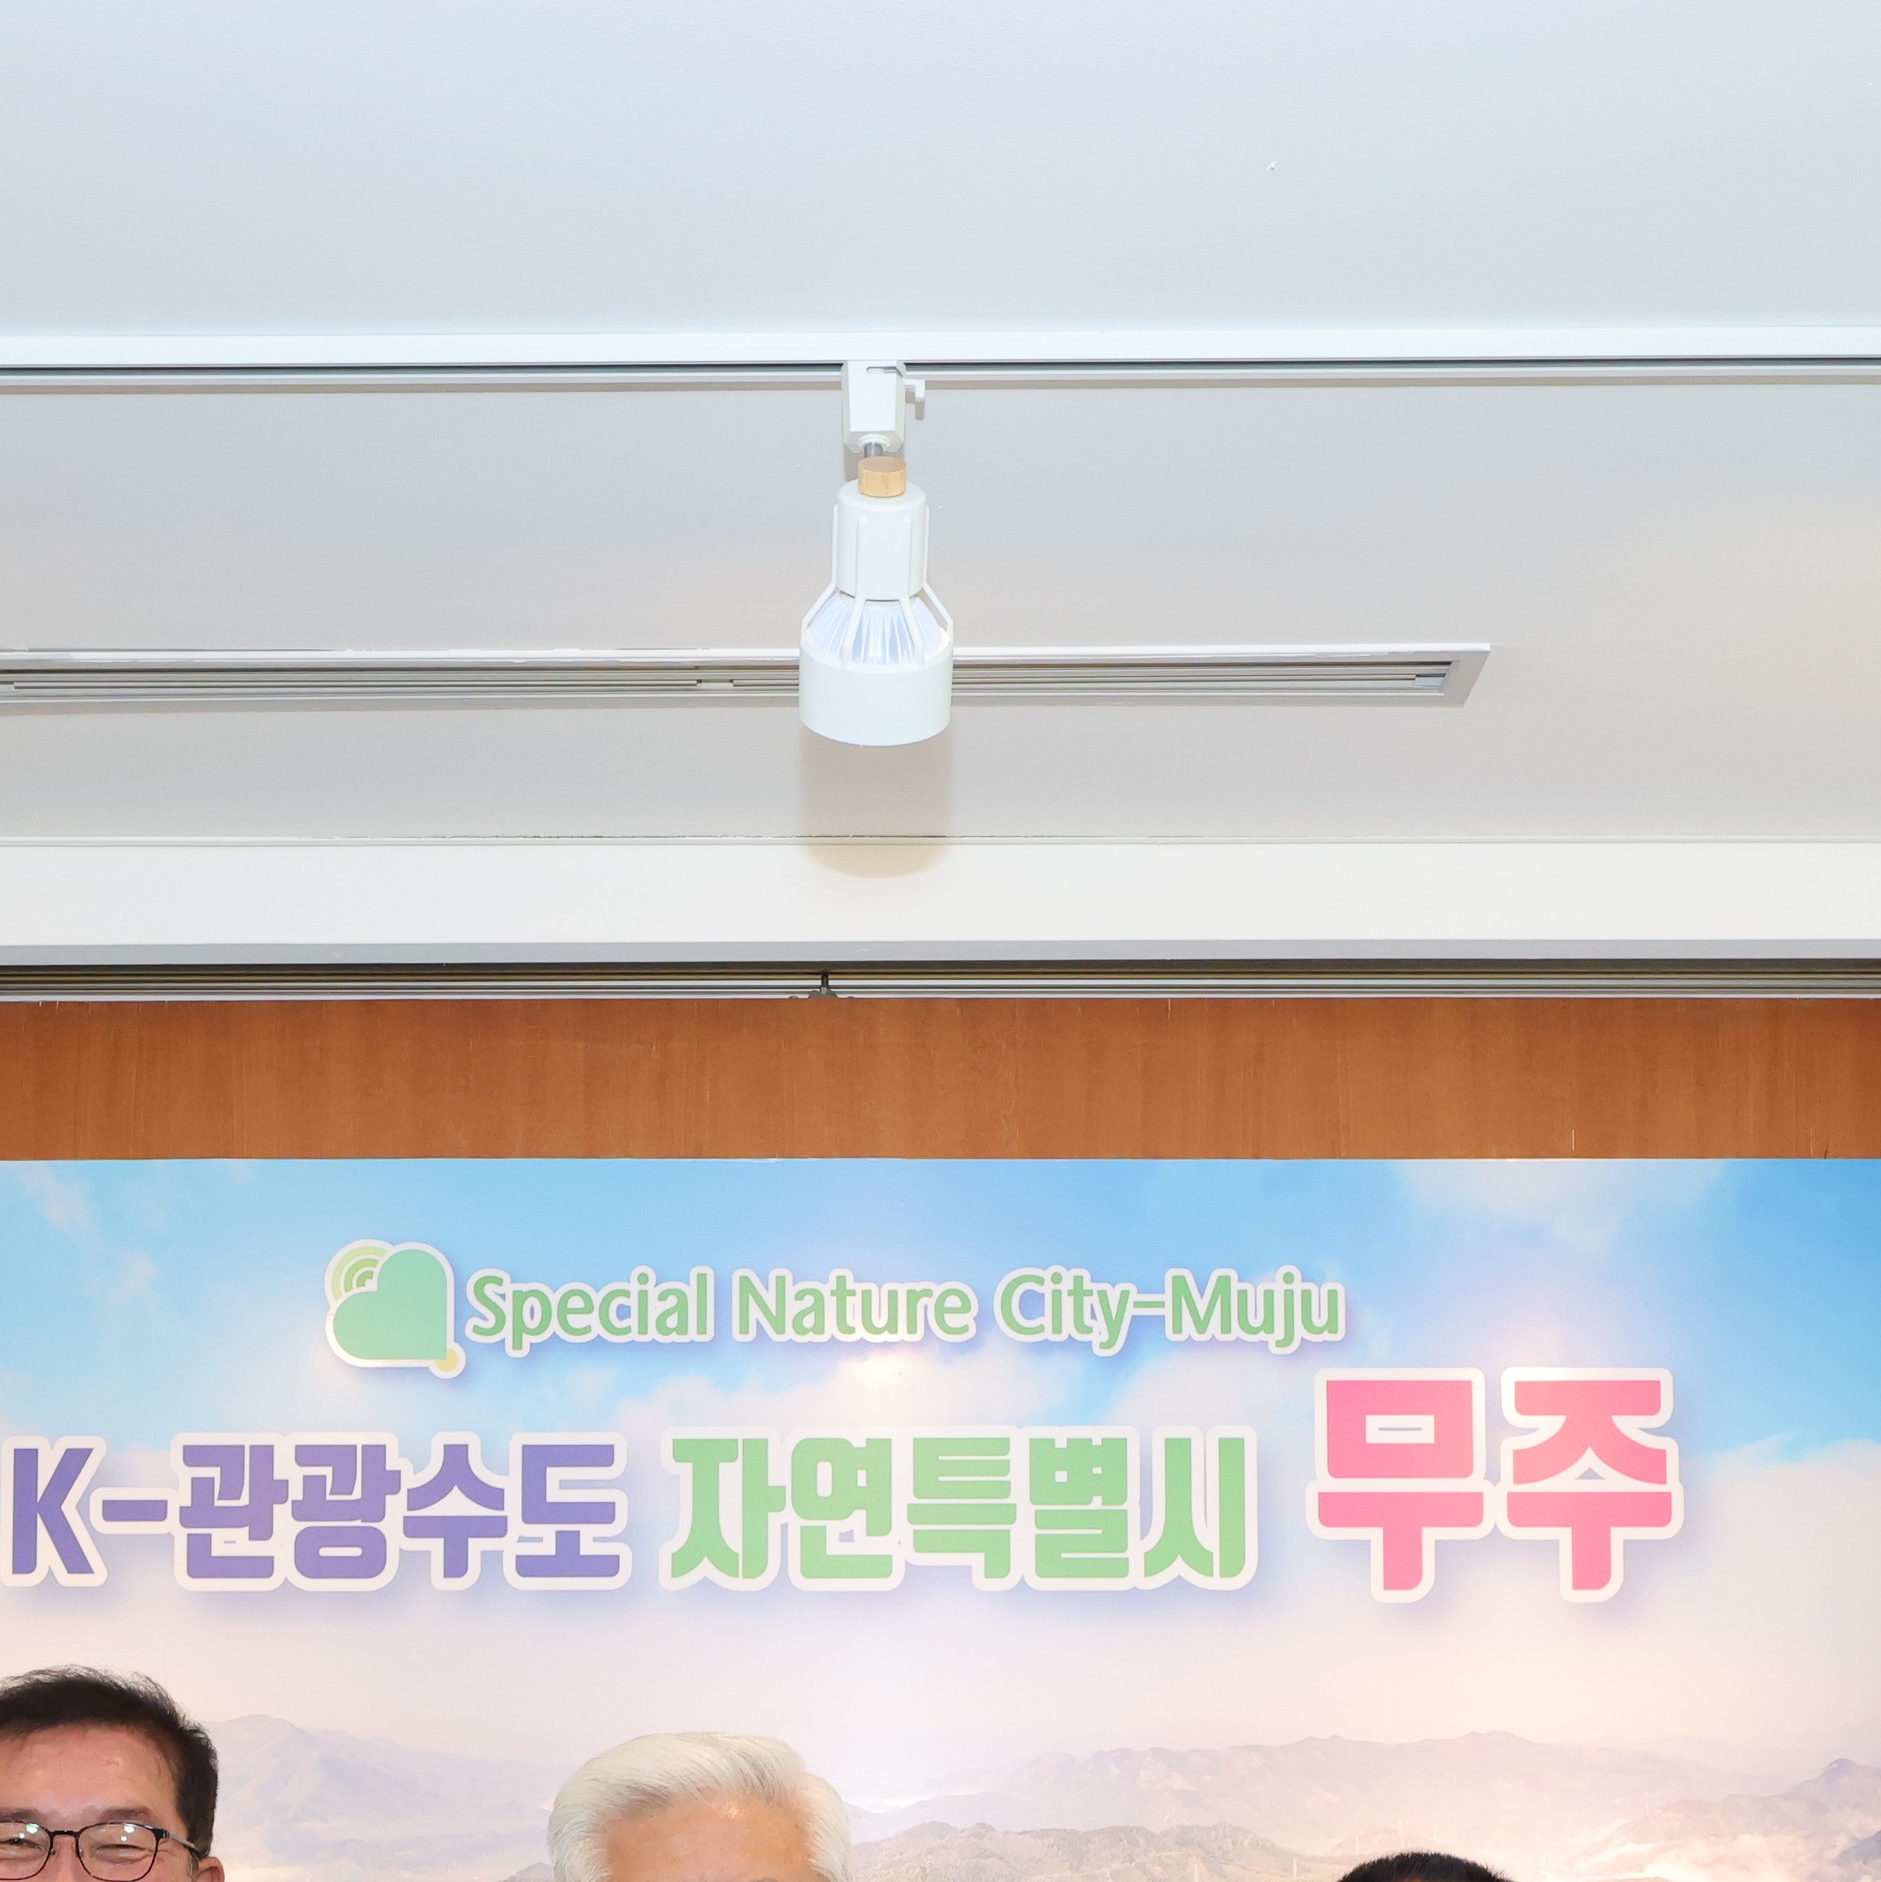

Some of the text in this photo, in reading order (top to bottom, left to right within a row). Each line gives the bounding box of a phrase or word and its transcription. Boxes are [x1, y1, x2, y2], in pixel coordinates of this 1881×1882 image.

[473, 1268, 1339, 1351] Special Nature City-Muju
[15, 1380, 1672, 1590] K-관광수도 자연특별시 무주
